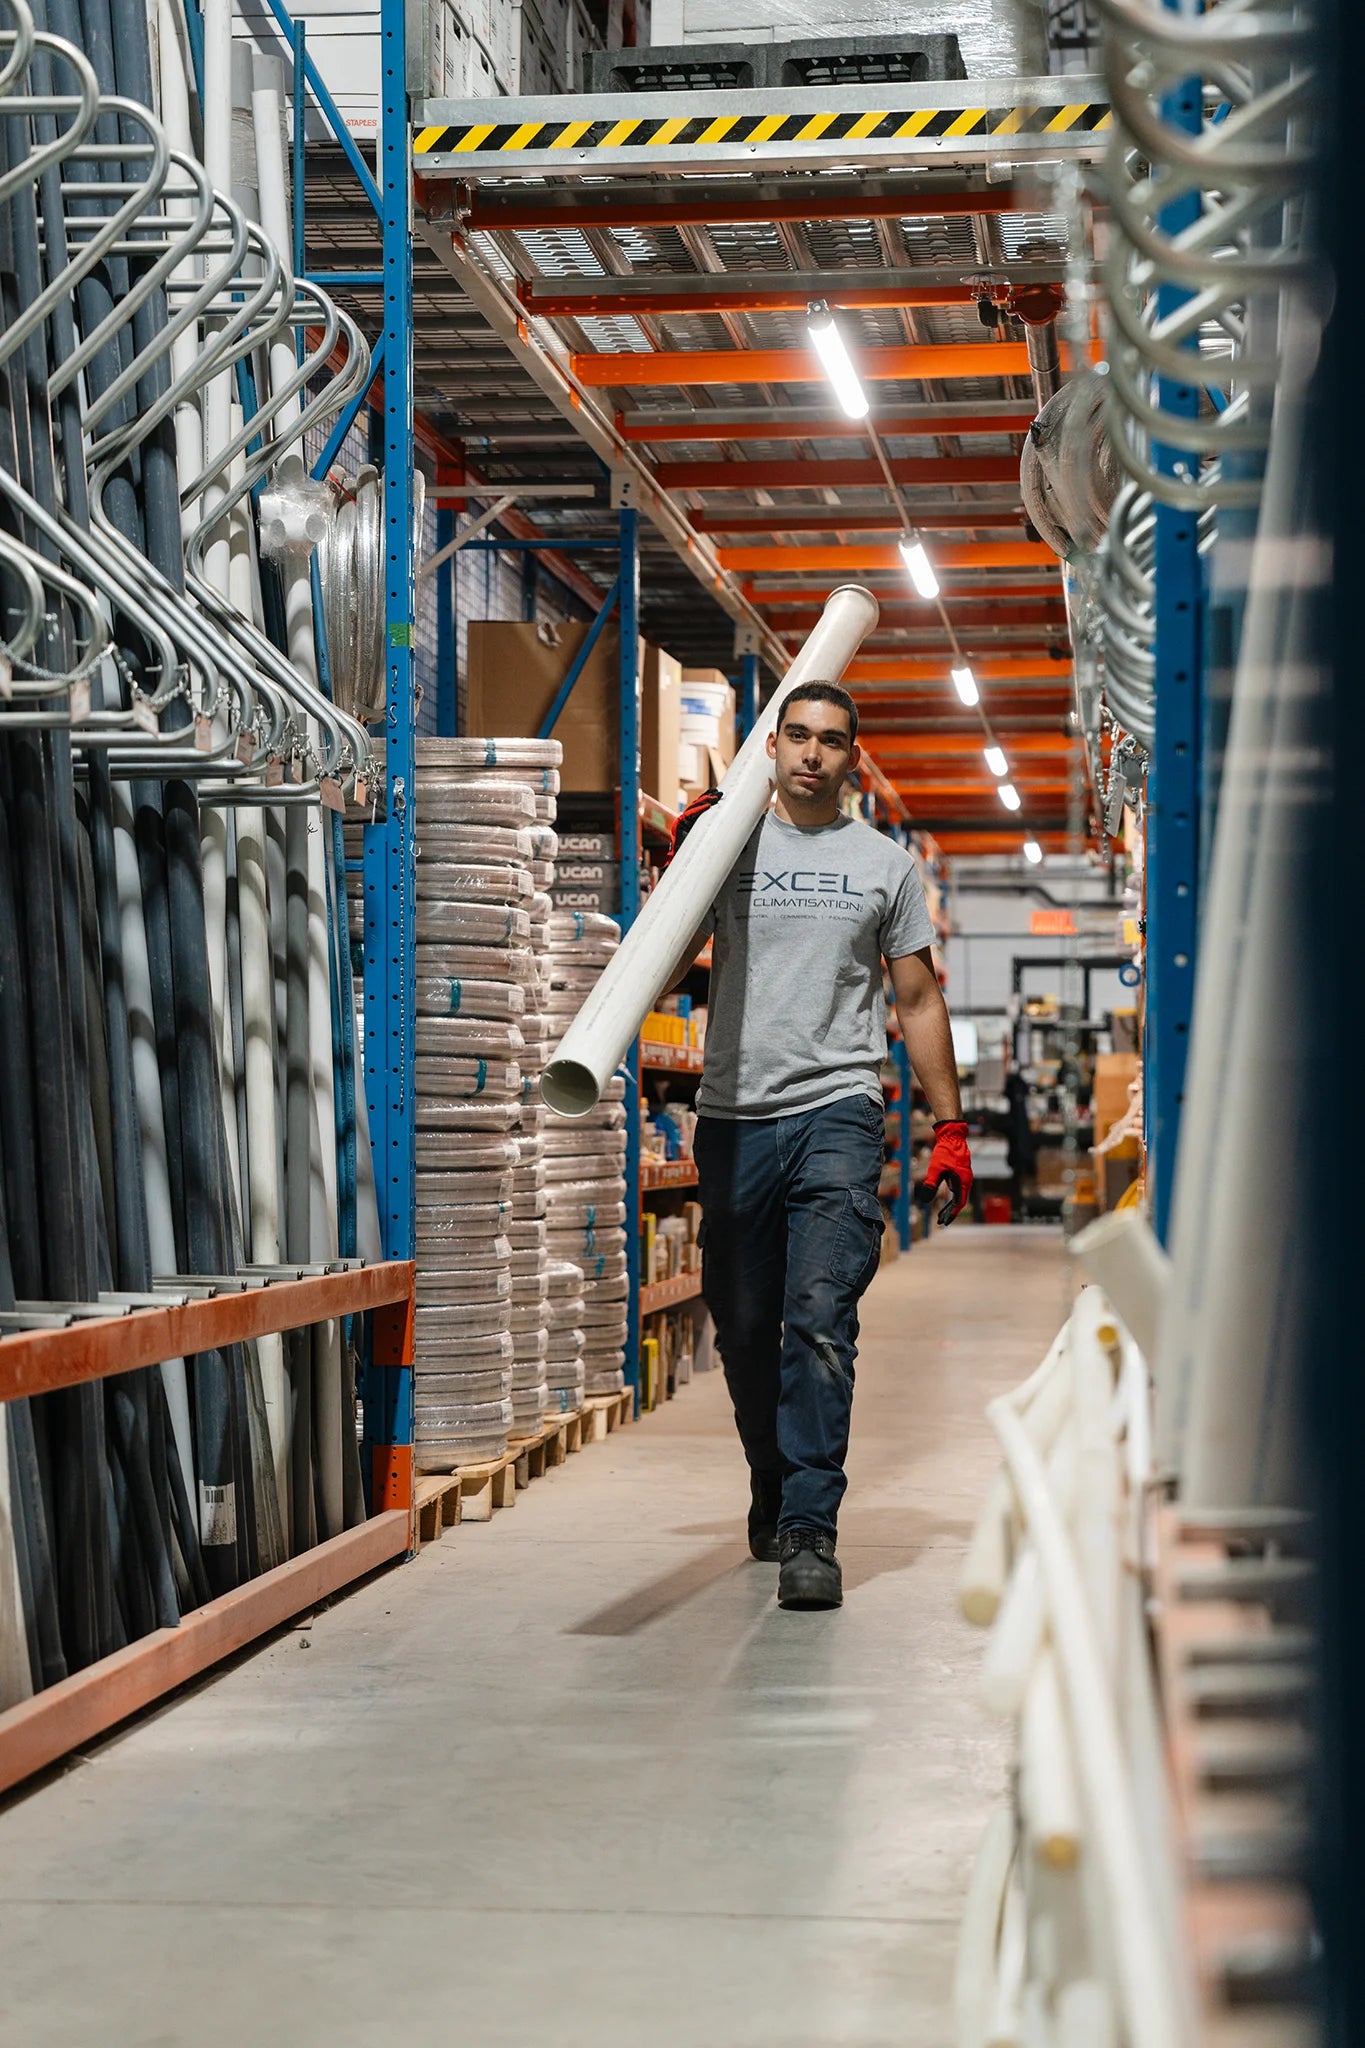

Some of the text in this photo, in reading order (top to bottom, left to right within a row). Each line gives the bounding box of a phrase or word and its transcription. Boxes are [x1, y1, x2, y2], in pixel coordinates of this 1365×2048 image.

[345, 119, 377, 127] STAPLES
[559, 837, 601, 850] UCAN
[559, 866, 603, 879] UCAN
[737, 871, 863, 897] EXCEL
[555, 893, 600, 906] UCAN
[753, 898, 860, 913] CLIMATISATION
